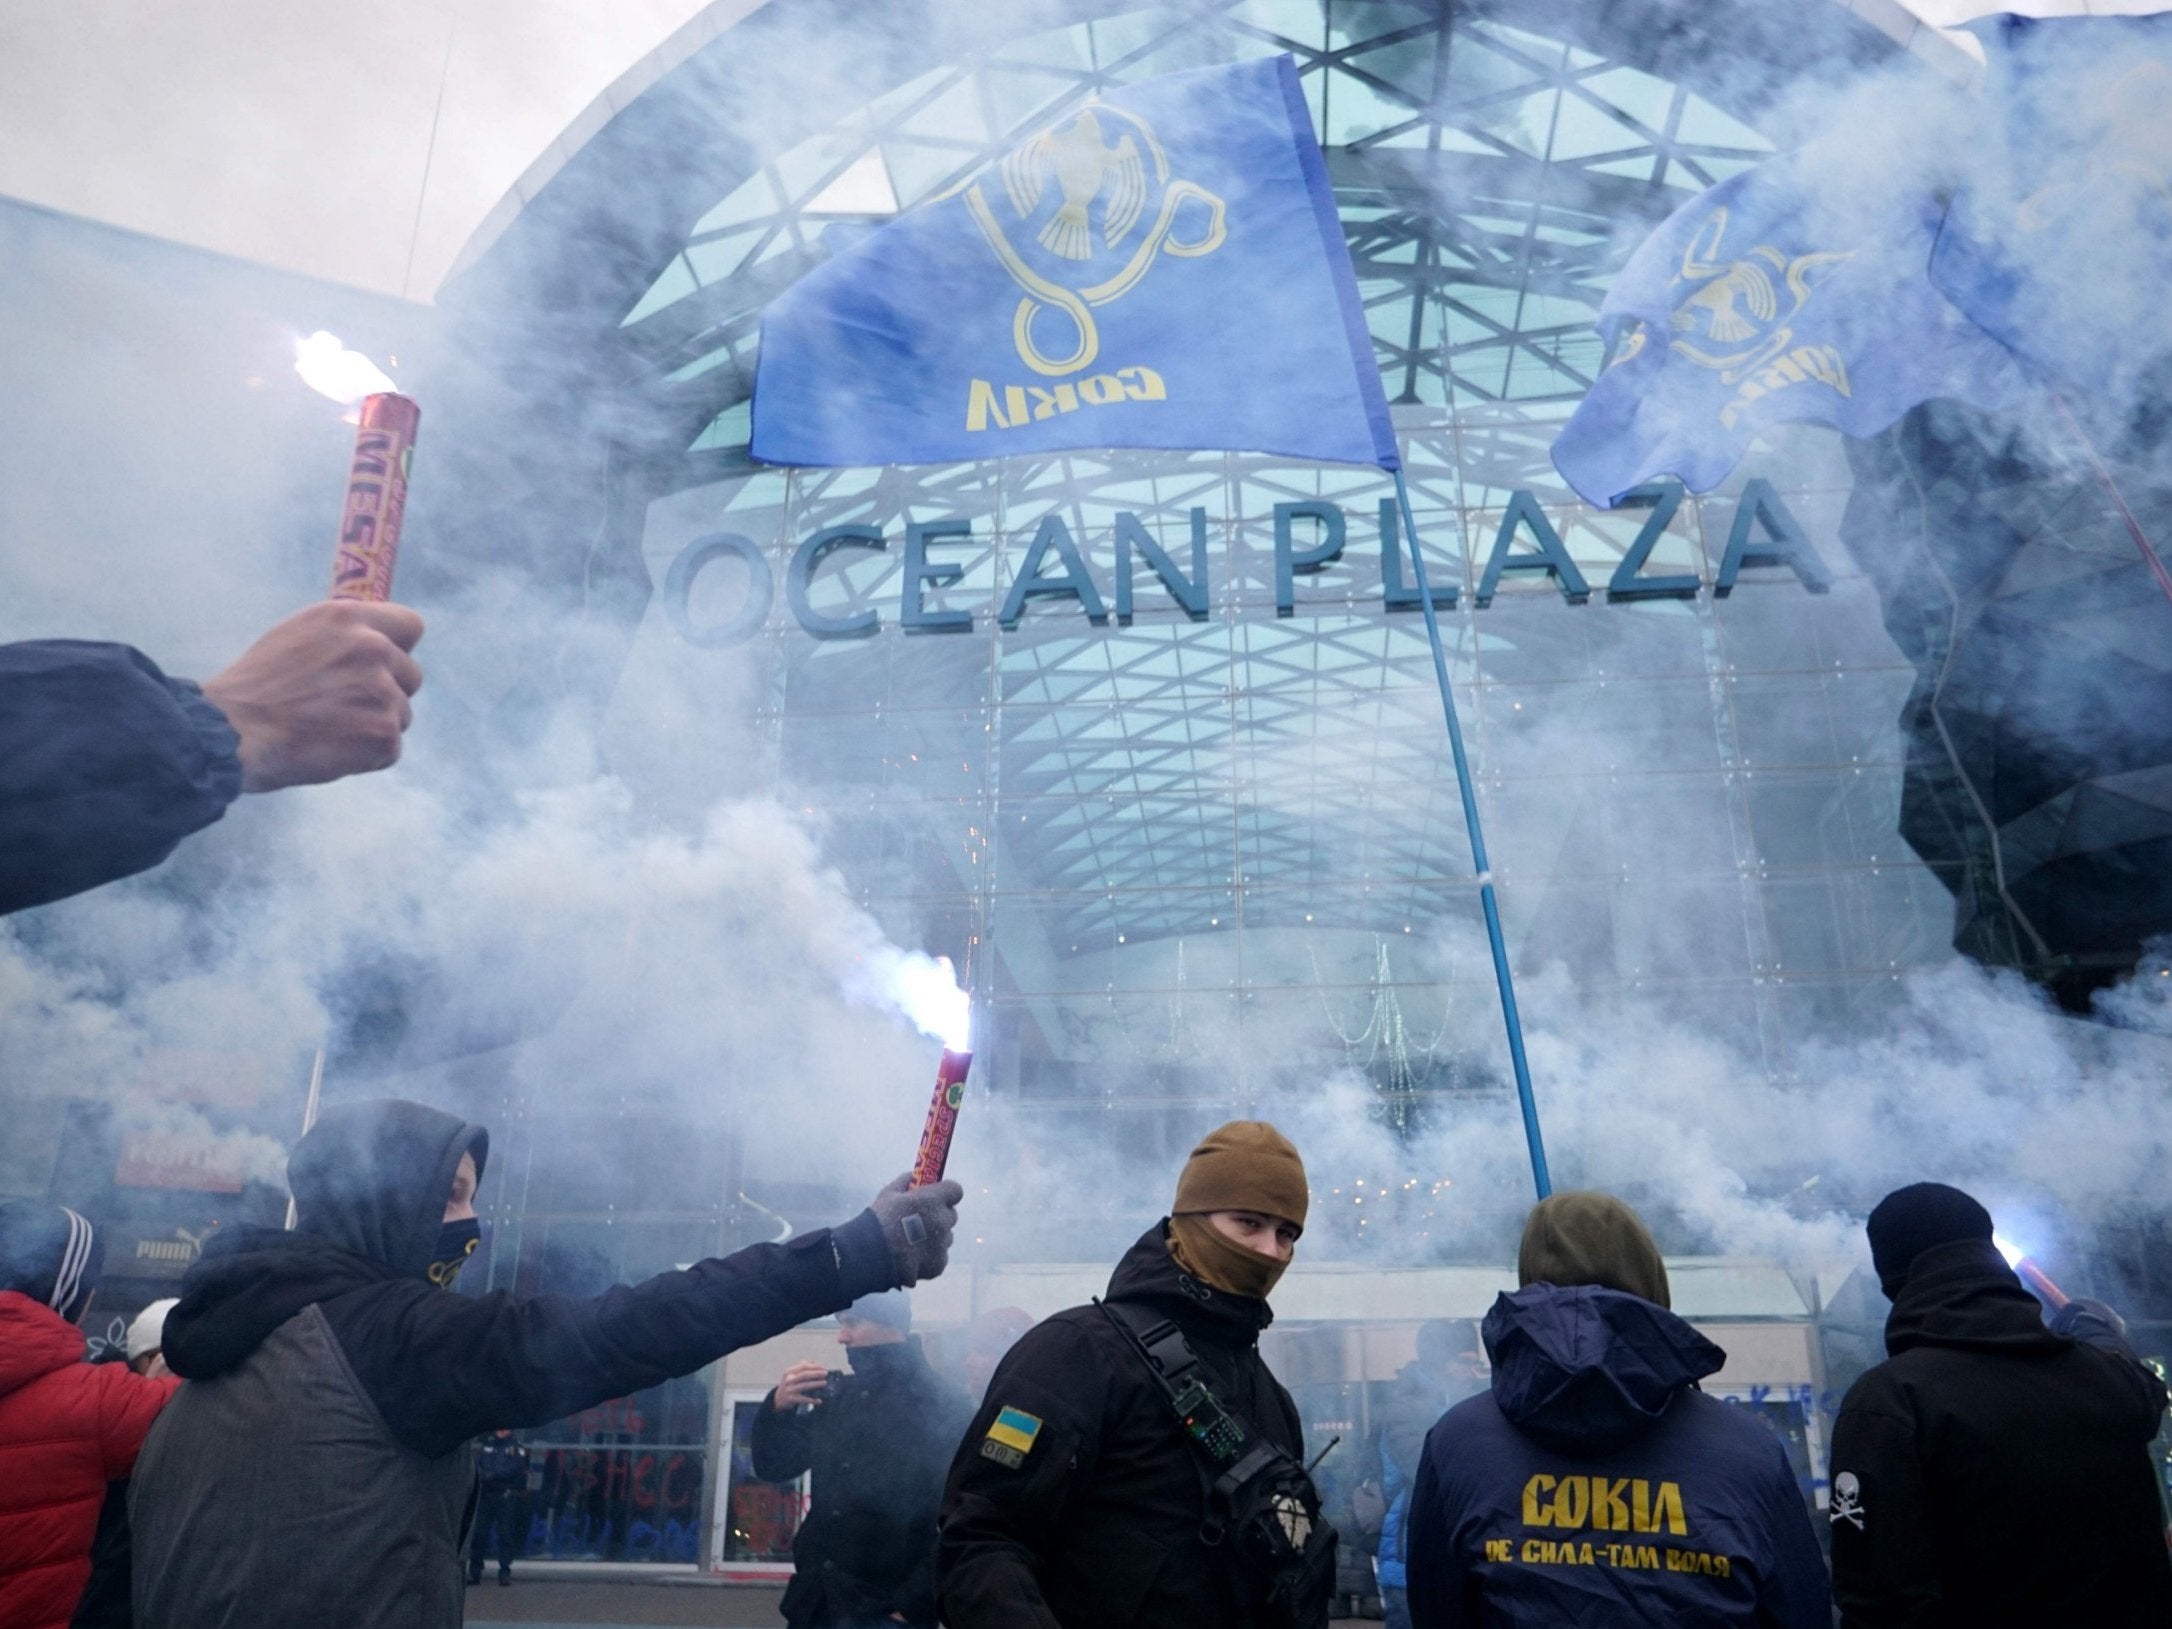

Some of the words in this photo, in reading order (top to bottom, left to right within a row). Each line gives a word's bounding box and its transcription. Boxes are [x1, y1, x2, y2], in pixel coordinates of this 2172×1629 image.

[664, 506, 1210, 649] OCEAN
[1273, 477, 1834, 618] PLAZA
[136, 1240, 191, 1259] PUMA
[1522, 1473, 1688, 1536] СОКІЛ
